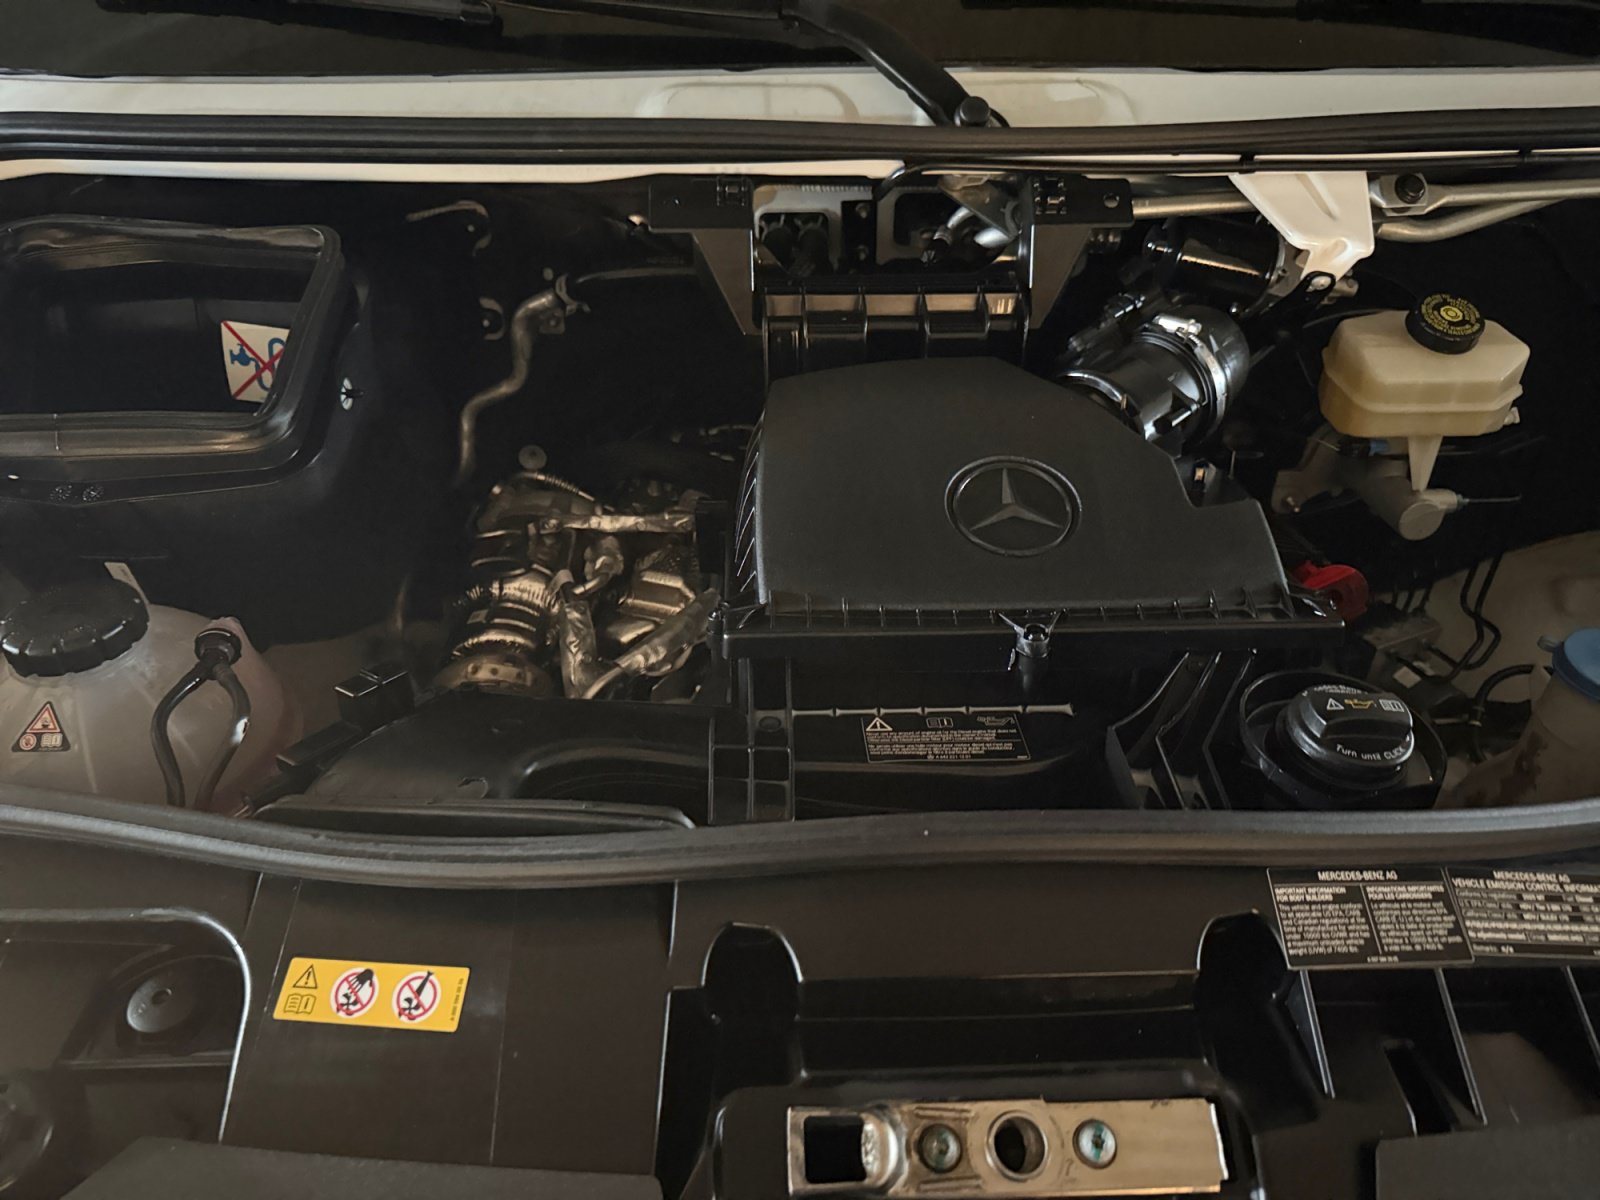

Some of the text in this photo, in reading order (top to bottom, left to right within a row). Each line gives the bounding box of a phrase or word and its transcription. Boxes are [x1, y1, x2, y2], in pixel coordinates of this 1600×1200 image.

[1336, 743, 1406, 760] Turn until CLICK
[1317, 870, 1398, 881] MERCEDES-BENZ AG
[1493, 869, 1571, 883] MERCEDES-BENZ AG
[1452, 877, 1486, 889] VEHICLE
[1486, 879, 1525, 891] EMISSION
[1525, 881, 1563, 893] CONTROL
